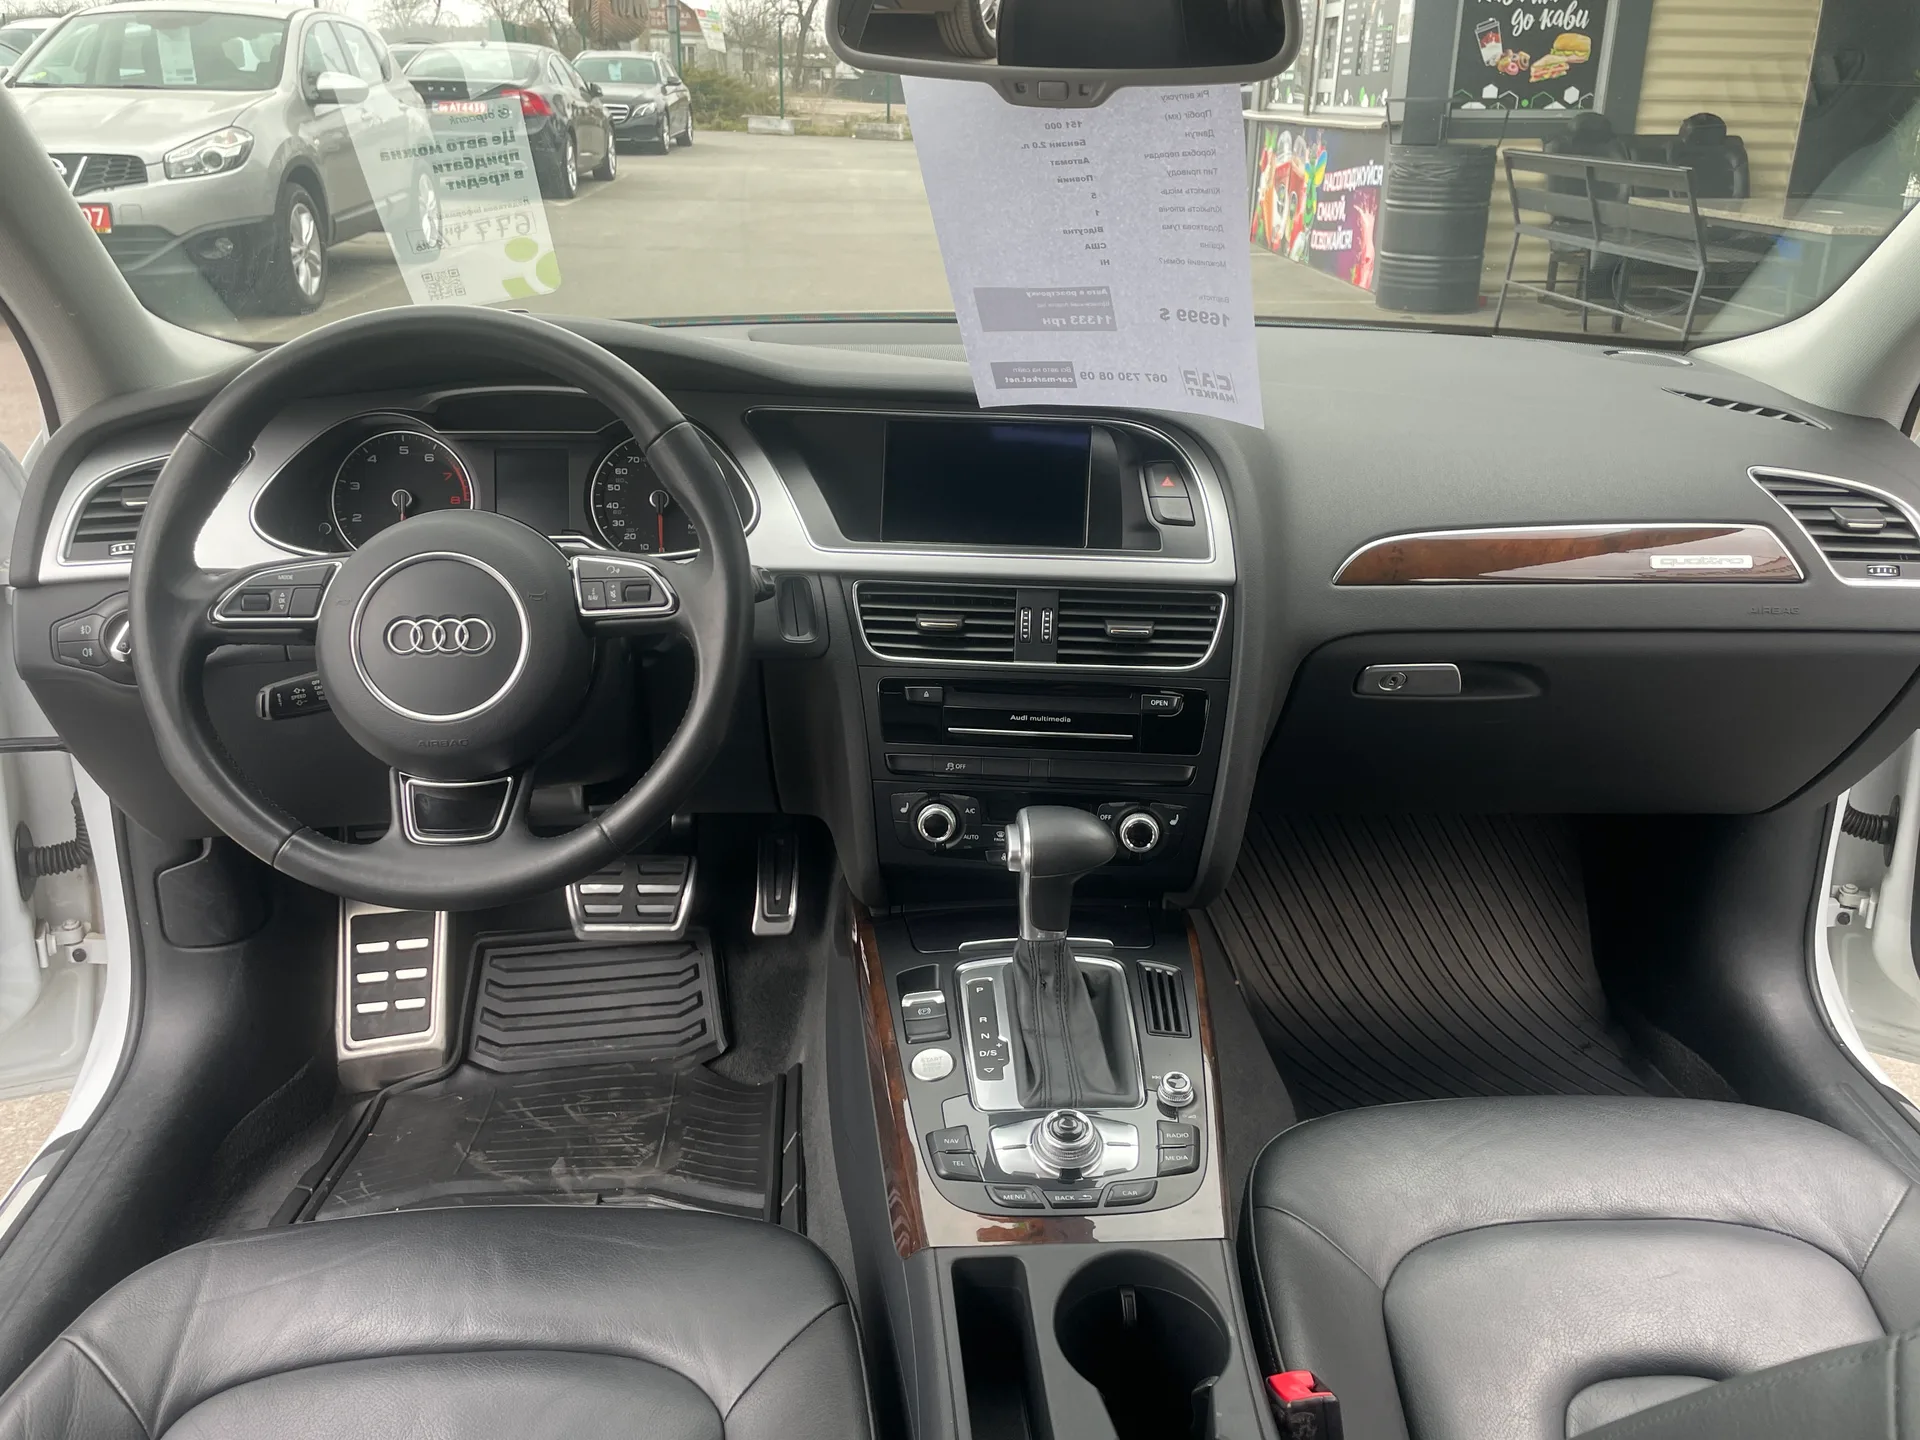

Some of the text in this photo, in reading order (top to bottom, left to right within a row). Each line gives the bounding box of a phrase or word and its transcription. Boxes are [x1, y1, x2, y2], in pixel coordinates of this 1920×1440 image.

[399, 446, 409, 455] 5
[367, 454, 378, 463] 4
[424, 453, 435, 462] 6
[627, 456, 640, 464] 70
[442, 472, 452, 481] 7
[350, 481, 360, 490] 3
[450, 496, 461, 505] 8
[352, 513, 362, 522] 2
[1659, 556, 1744, 567] quattro
[1749, 605, 1800, 616] AIRBAG
[1150, 699, 1169, 707] OPEN
[1010, 714, 1072, 724] Audi multimedia
[417, 739, 469, 748] AIRBAG
[964, 807, 976, 815] A/C
[963, 833, 980, 841] AUTO
[979, 1049, 998, 1057] D/S
[1165, 1131, 1190, 1139] RADIO
[1164, 1154, 1189, 1162] MEDIA
[1003, 1193, 1027, 1201] MENU
